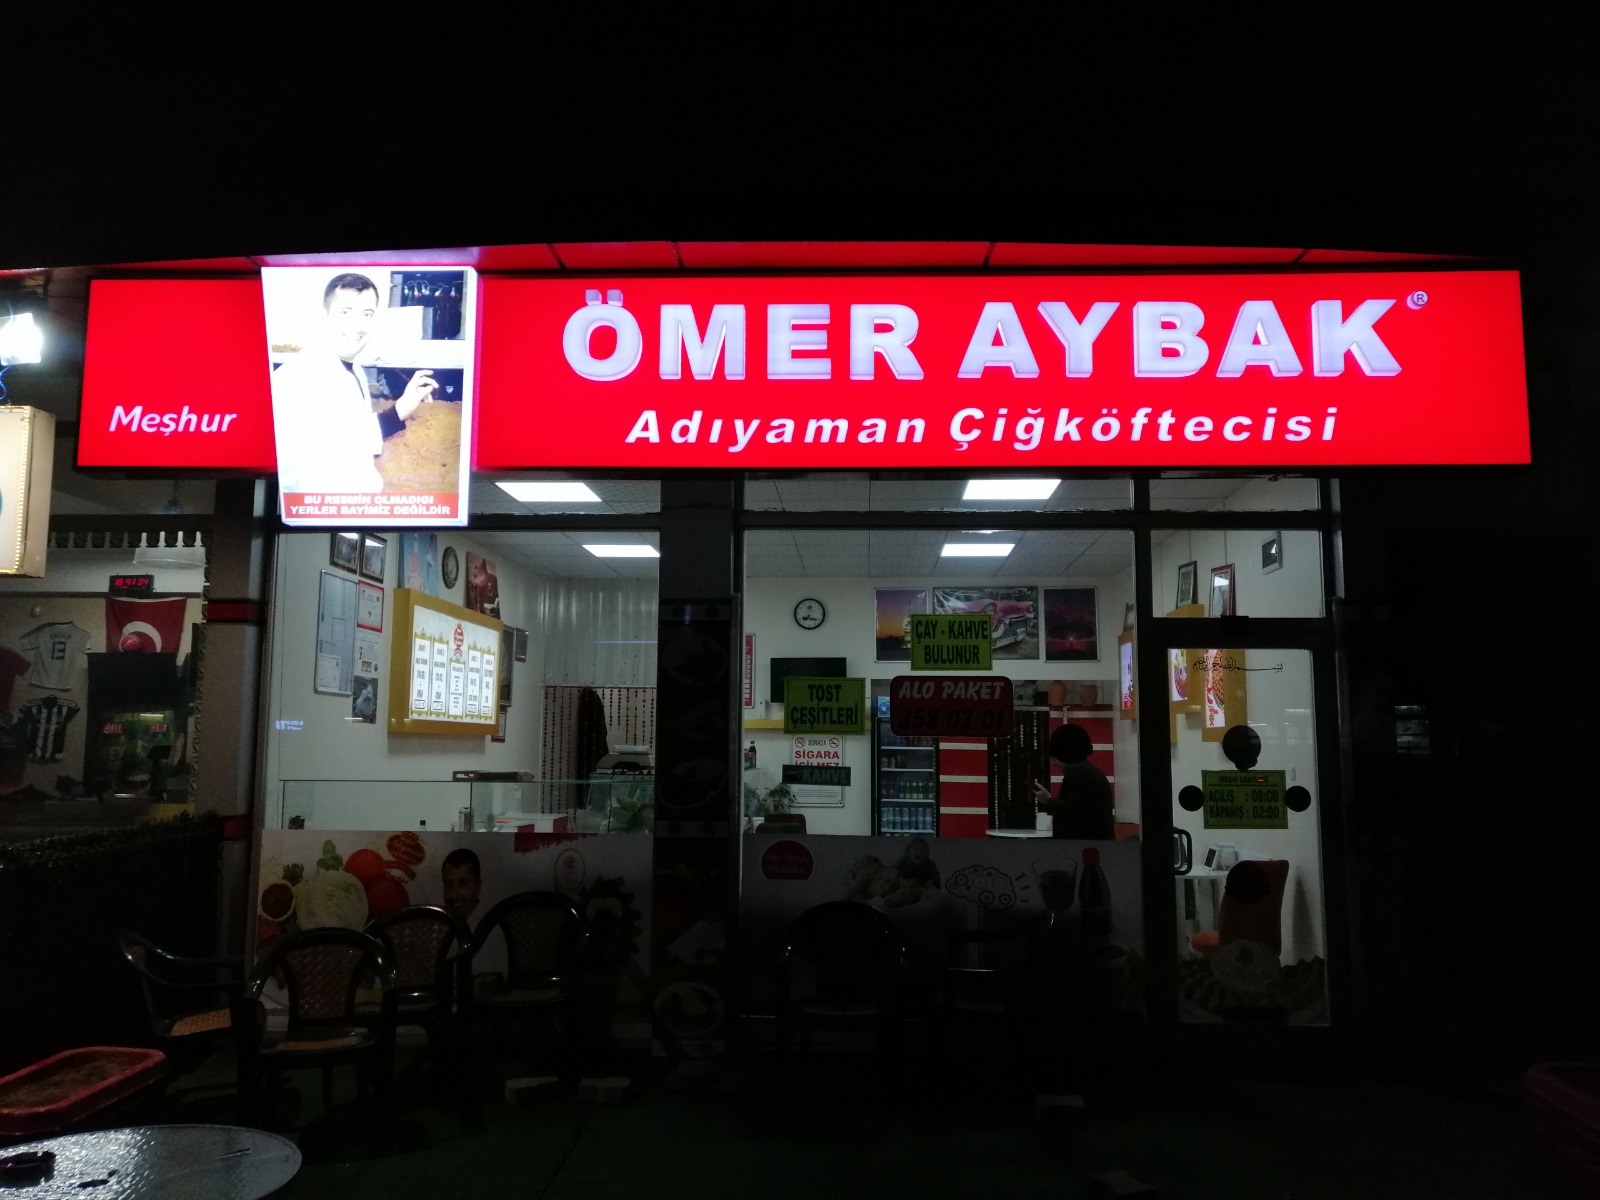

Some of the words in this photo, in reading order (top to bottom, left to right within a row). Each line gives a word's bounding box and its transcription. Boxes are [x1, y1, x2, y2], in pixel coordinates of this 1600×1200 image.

[562, 289, 924, 381] ÖMER
[957, 299, 1402, 378] AYBAK
[108, 405, 237, 435] Meşhur
[625, 410, 926, 453] Adıyaman
[949, 407, 1338, 451] Çiğköftecisi
[304, 495, 322, 505] BU
[324, 493, 371, 505] RESMİN
[290, 505, 338, 515] YERLER
[341, 504, 391, 515] BAYİMİZ
[393, 504, 451, 515] DEĞİLDİR
[915, 620, 938, 645] ÇAY
[948, 620, 988, 640] KAHVE
[924, 645, 981, 665] BULUNUR
[807, 684, 842, 703] TOST
[898, 681, 935, 699] ALO
[941, 681, 1005, 700] PAKET
[790, 703, 859, 730] ÇEŞİTLERİ
[899, 708, 940, 730] 358
[946, 708, 974, 730] 02
[981, 708, 1005, 731] 01
[794, 749, 840, 759] SİGARA
[802, 767, 849, 784] KAHVE
[1251, 789, 1279, 802] 08:00
[1252, 806, 1280, 819] 02:00
